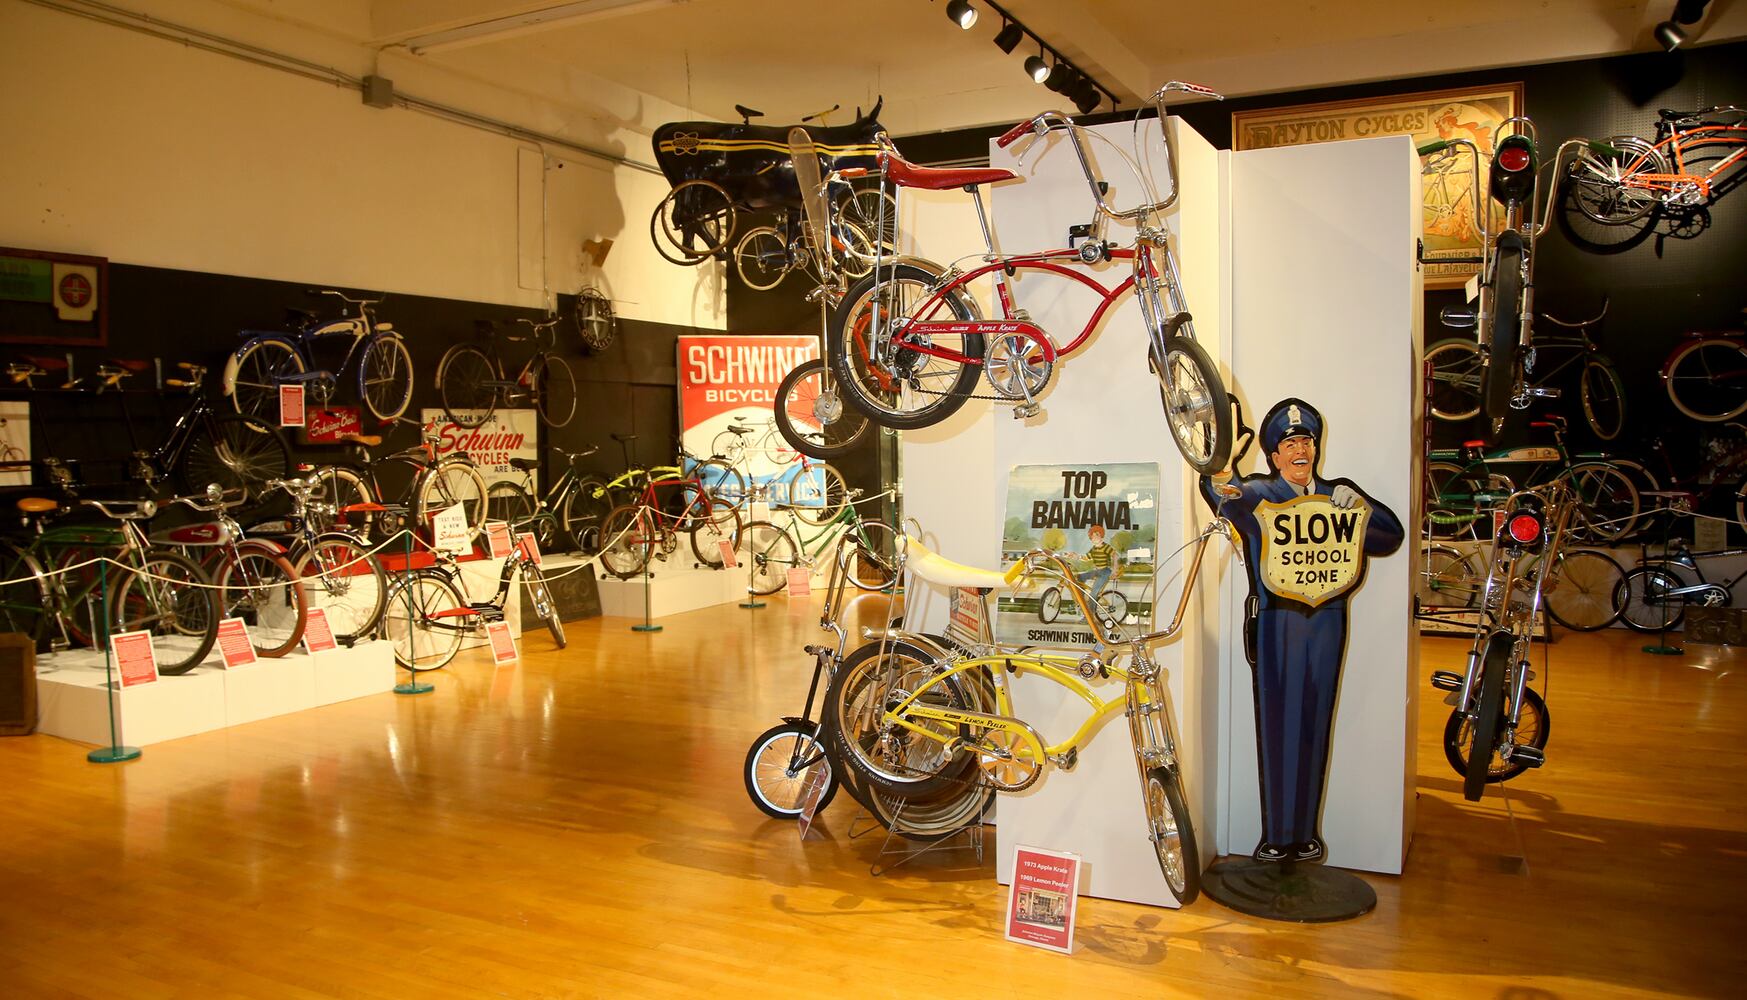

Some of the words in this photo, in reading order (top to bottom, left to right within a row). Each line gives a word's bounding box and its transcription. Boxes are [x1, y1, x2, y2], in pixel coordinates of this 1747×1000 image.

[1353, 112, 1425, 136] CYCLES
[688, 345, 814, 385] SCHWINN
[706, 389, 799, 403] BICYCLS
[436, 423, 525, 453] Schwinn
[466, 452, 510, 465] CYCLES
[494, 465, 508, 473] ARE
[1062, 471, 1107, 498] TOP
[1031, 501, 1140, 531] BANANA.
[1273, 513, 1358, 545] SLOW
[1281, 549, 1351, 566] SCHOOL
[1295, 569, 1338, 584] ZONE
[1028, 629, 1070, 643] SCHWINN
[1071, 631, 1121, 644] STINGAY
[1037, 863, 1053, 871] Apple
[1033, 876, 1052, 885] Lemon
